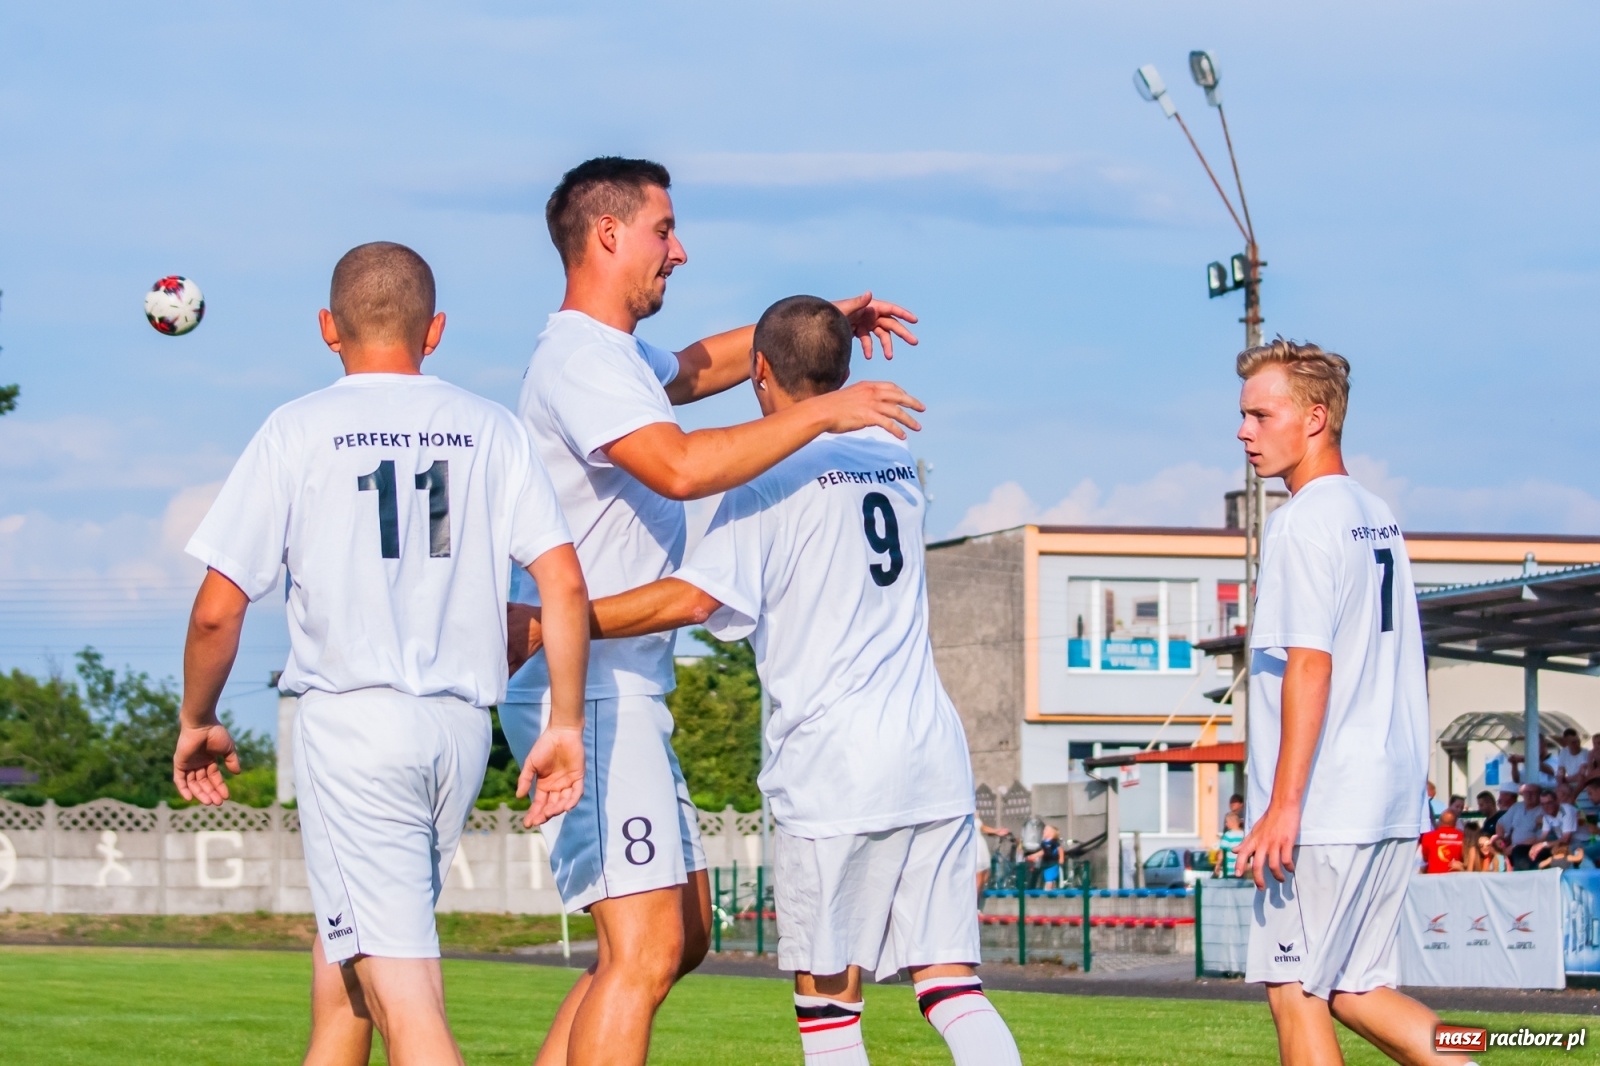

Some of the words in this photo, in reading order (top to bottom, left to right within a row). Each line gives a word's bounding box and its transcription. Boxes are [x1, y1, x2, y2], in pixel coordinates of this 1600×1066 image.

[333, 432, 412, 450] PERFEKT
[418, 431, 474, 448] HOME
[818, 471, 875, 490] PERFEKT
[876, 466, 915, 484] HOME
[357, 459, 452, 560] 11
[862, 491, 904, 587] 9
[1376, 524, 1400, 540] HOM
[622, 816, 655, 865] 8
[327, 926, 353, 940] erima
[1274, 954, 1301, 963] erima
